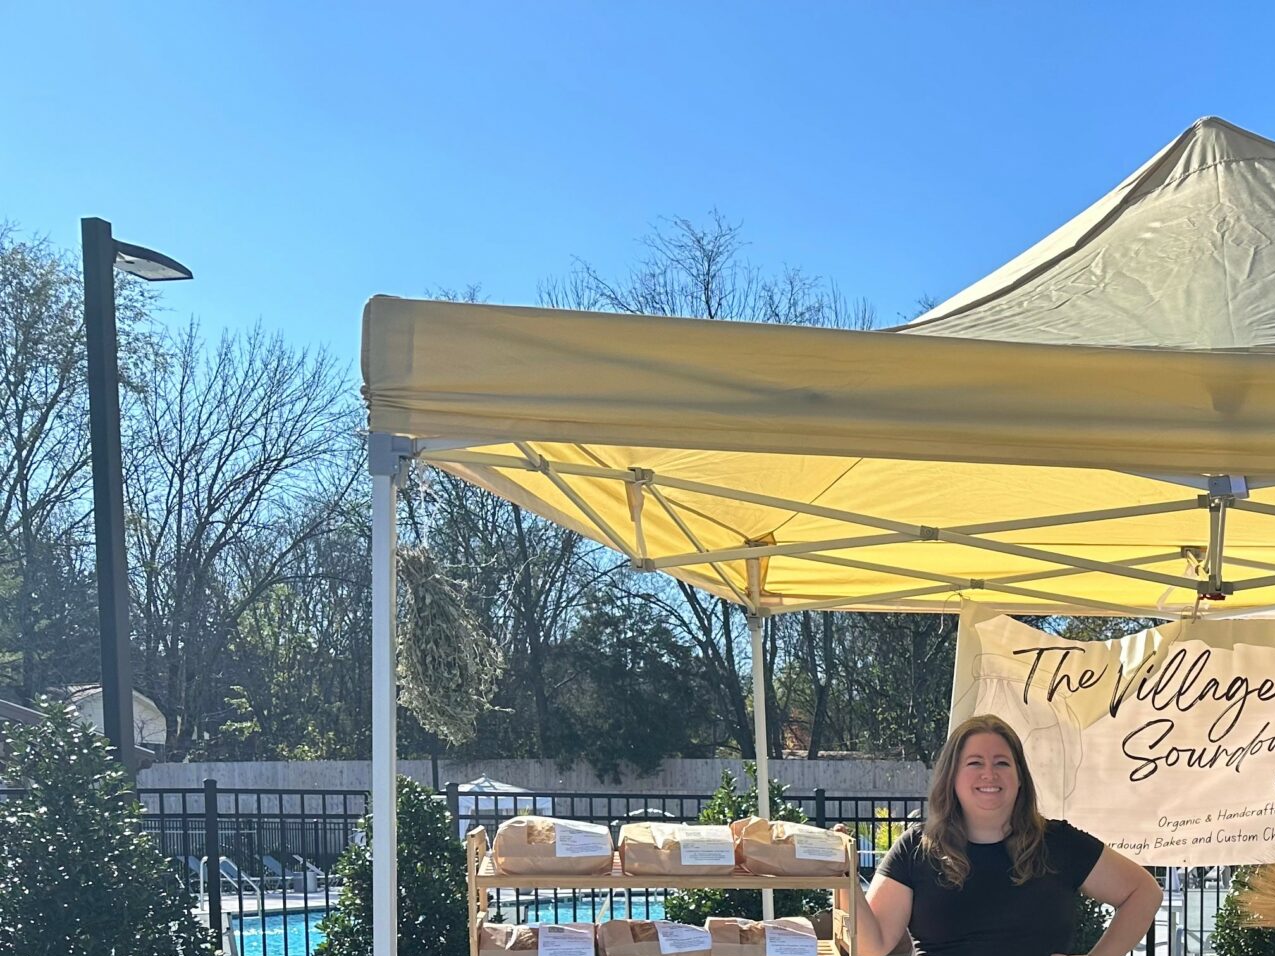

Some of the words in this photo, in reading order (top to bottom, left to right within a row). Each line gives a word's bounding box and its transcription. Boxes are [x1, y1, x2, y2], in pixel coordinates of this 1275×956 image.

[1013, 646, 1108, 705] The
[1158, 815, 1201, 832] Organic
[1205, 813, 1212, 823] &
[1108, 837, 1150, 855] rdough
[1154, 836, 1187, 849] Bakes
[1191, 831, 1213, 845] and
[1216, 828, 1259, 843] Custom
